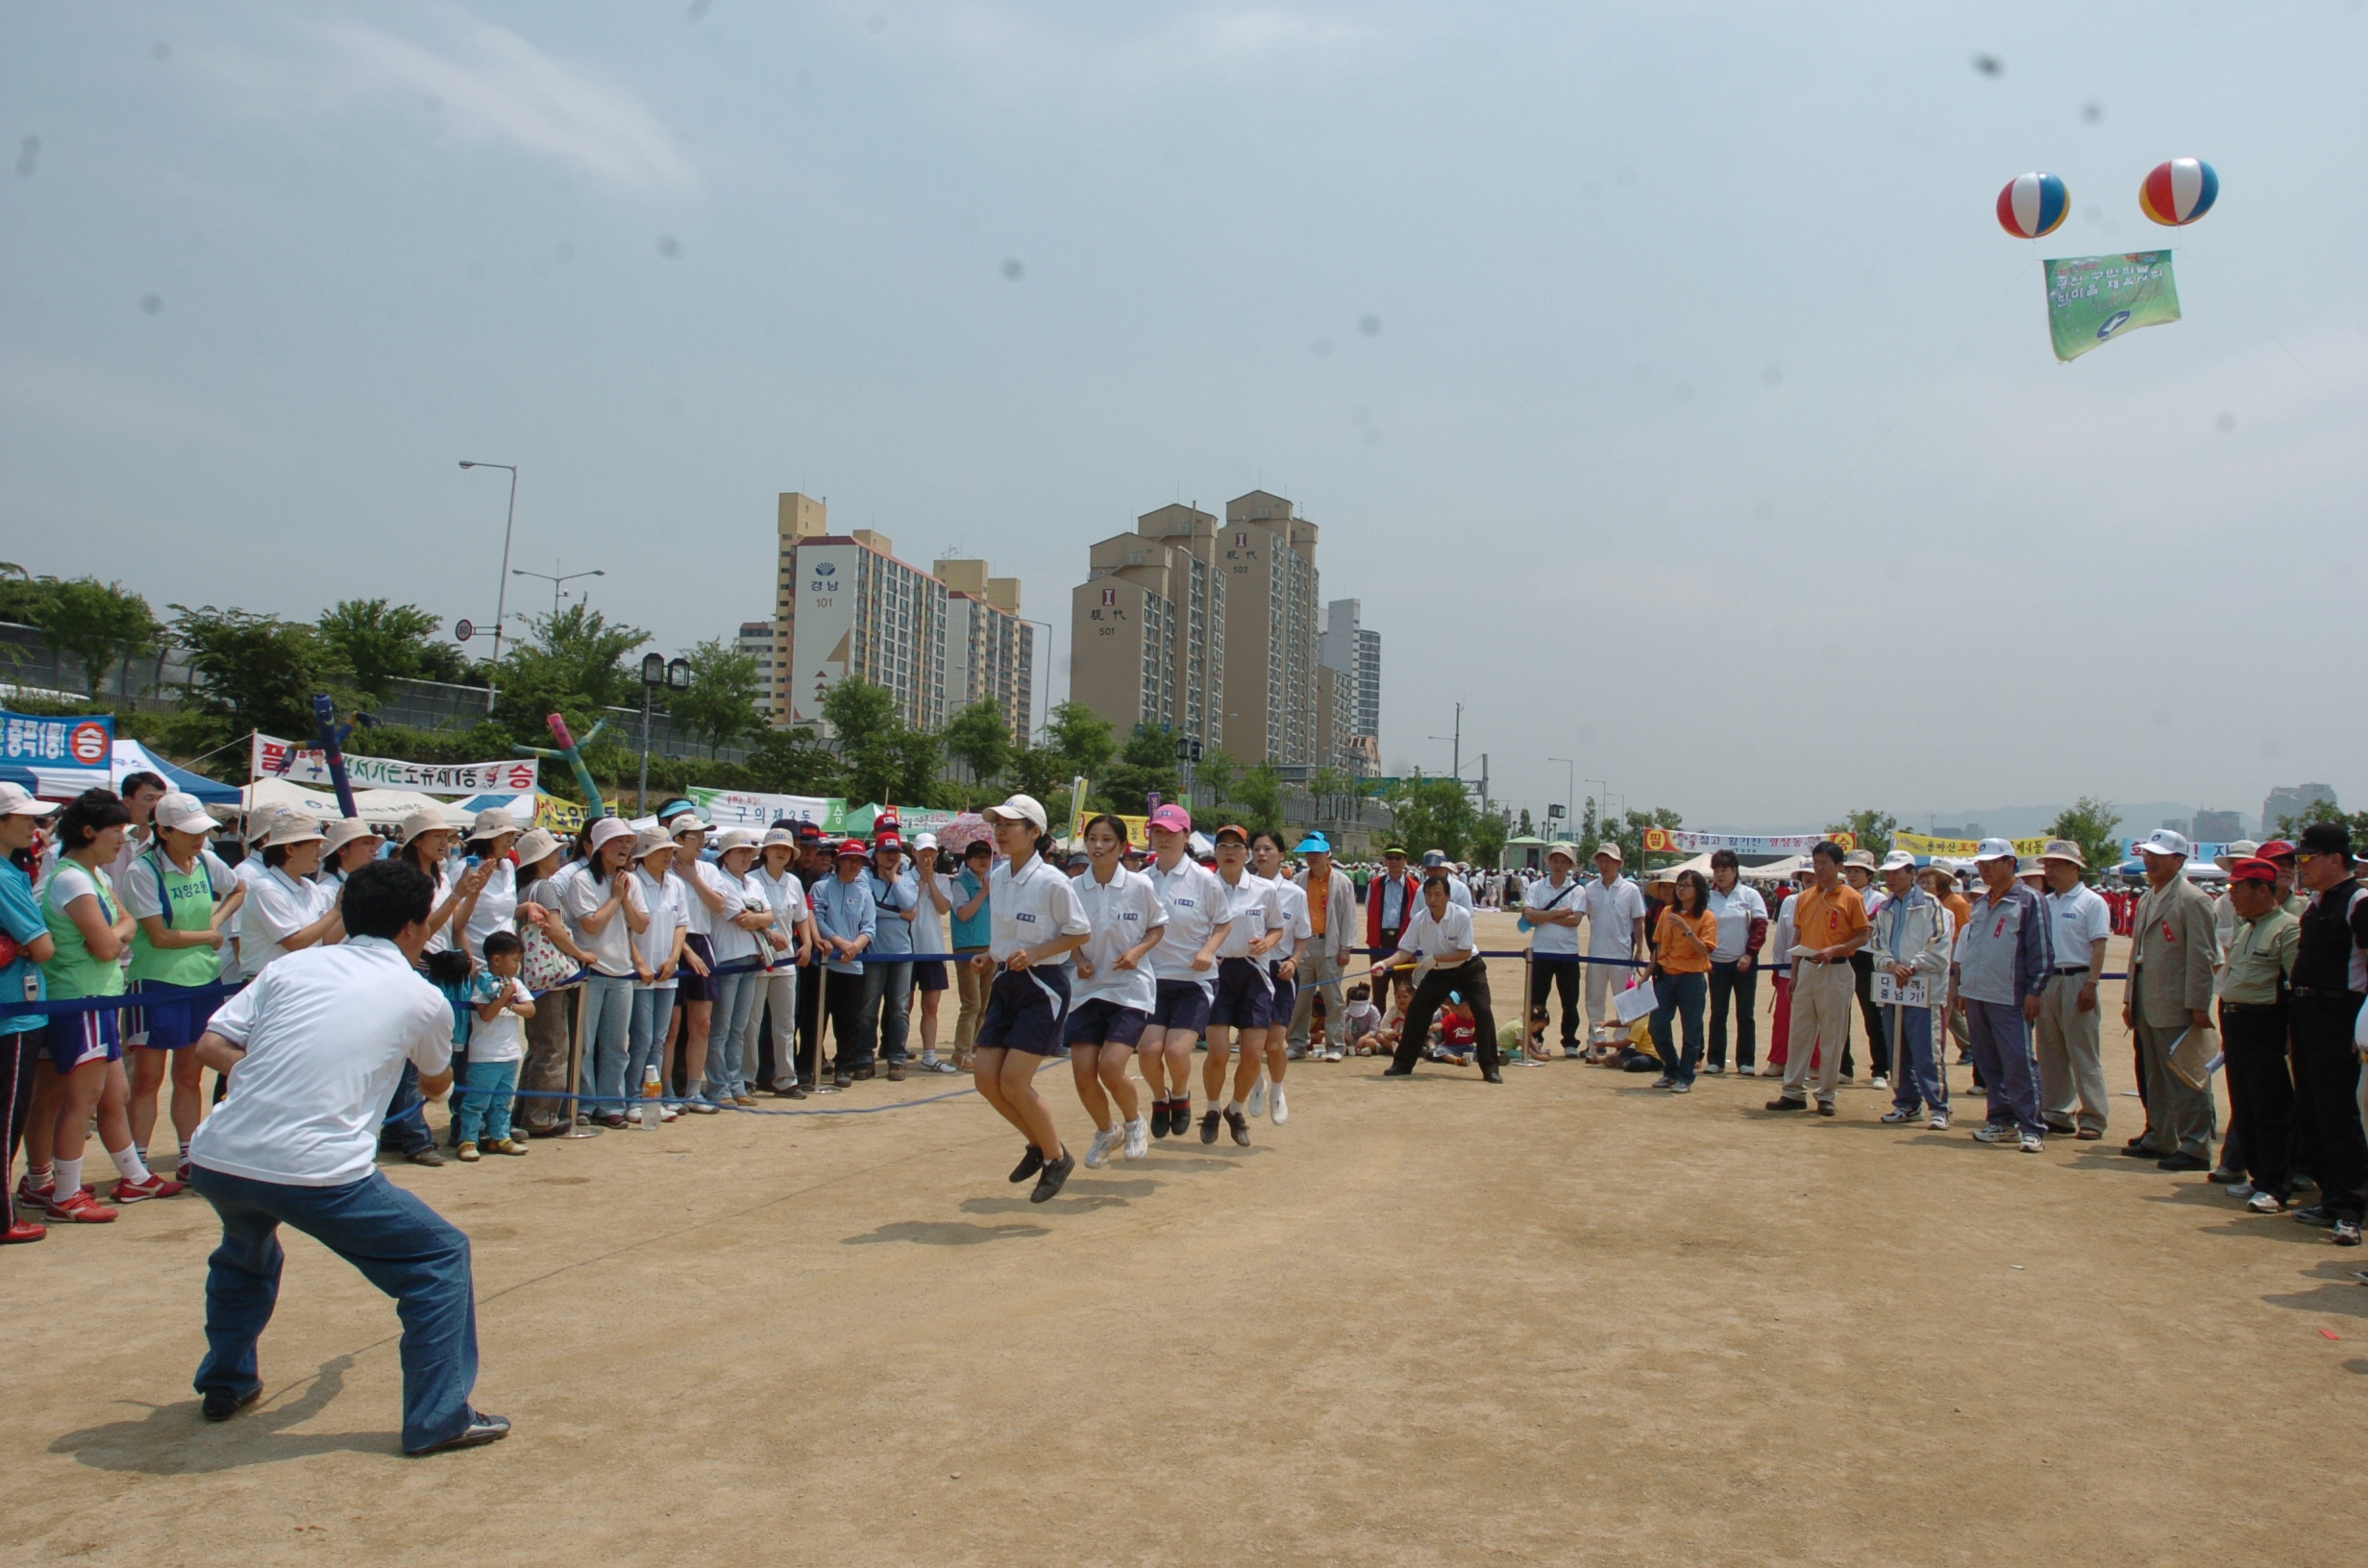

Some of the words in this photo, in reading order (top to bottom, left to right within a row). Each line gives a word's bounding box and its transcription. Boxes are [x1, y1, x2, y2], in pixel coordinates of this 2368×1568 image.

[810, 580, 839, 592] 경남
[816, 598, 833, 608] 101
[1099, 627, 1115, 636] 501
[77, 727, 104, 759] 승
[508, 764, 534, 789] 승
[833, 805, 844, 824] 승
